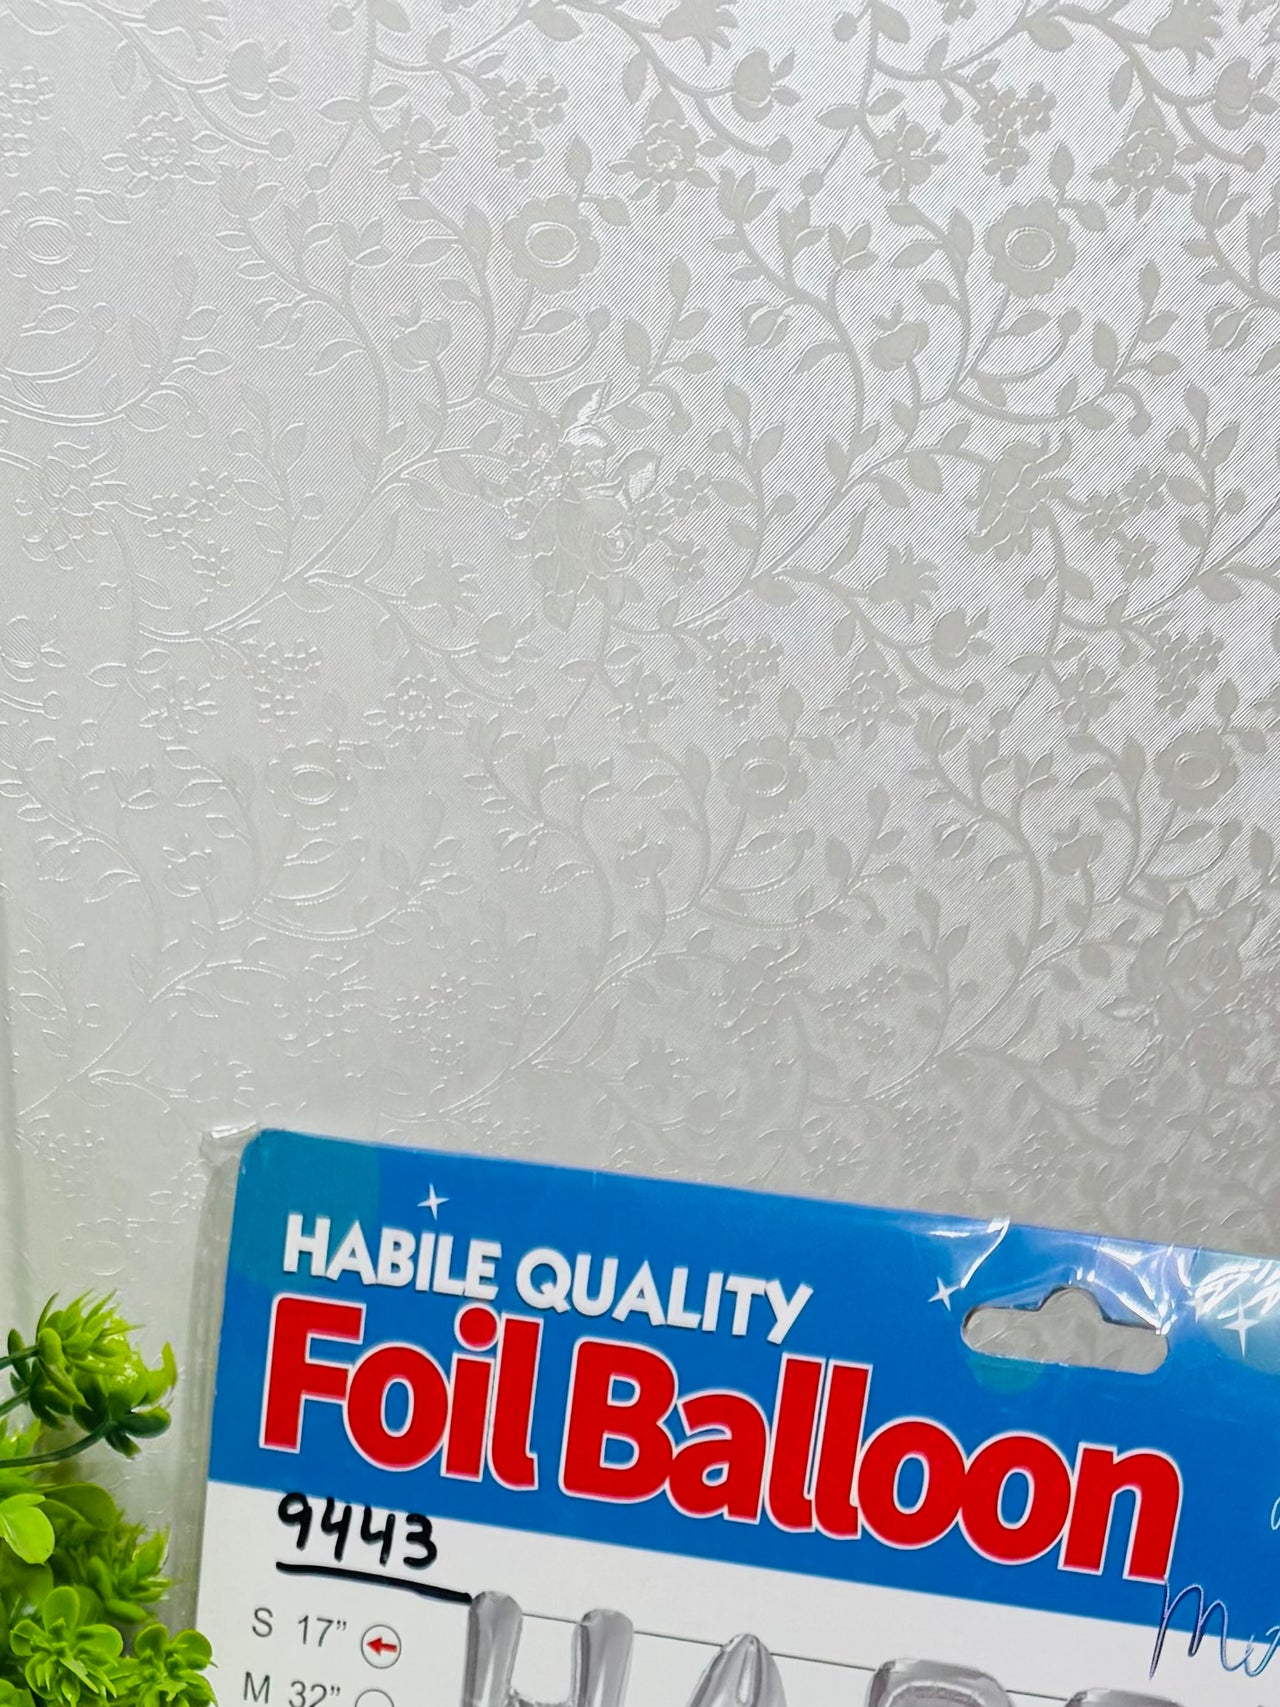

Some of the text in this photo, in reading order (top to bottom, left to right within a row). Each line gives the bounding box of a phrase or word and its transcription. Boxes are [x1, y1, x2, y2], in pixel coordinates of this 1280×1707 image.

[282, 1213, 812, 1346] HABILE QUALITY
[260, 1294, 1182, 1584] Foil Balloon
[278, 1492, 438, 1569] 9443
[252, 1607, 273, 1637] S
[243, 1671, 270, 1704] M
